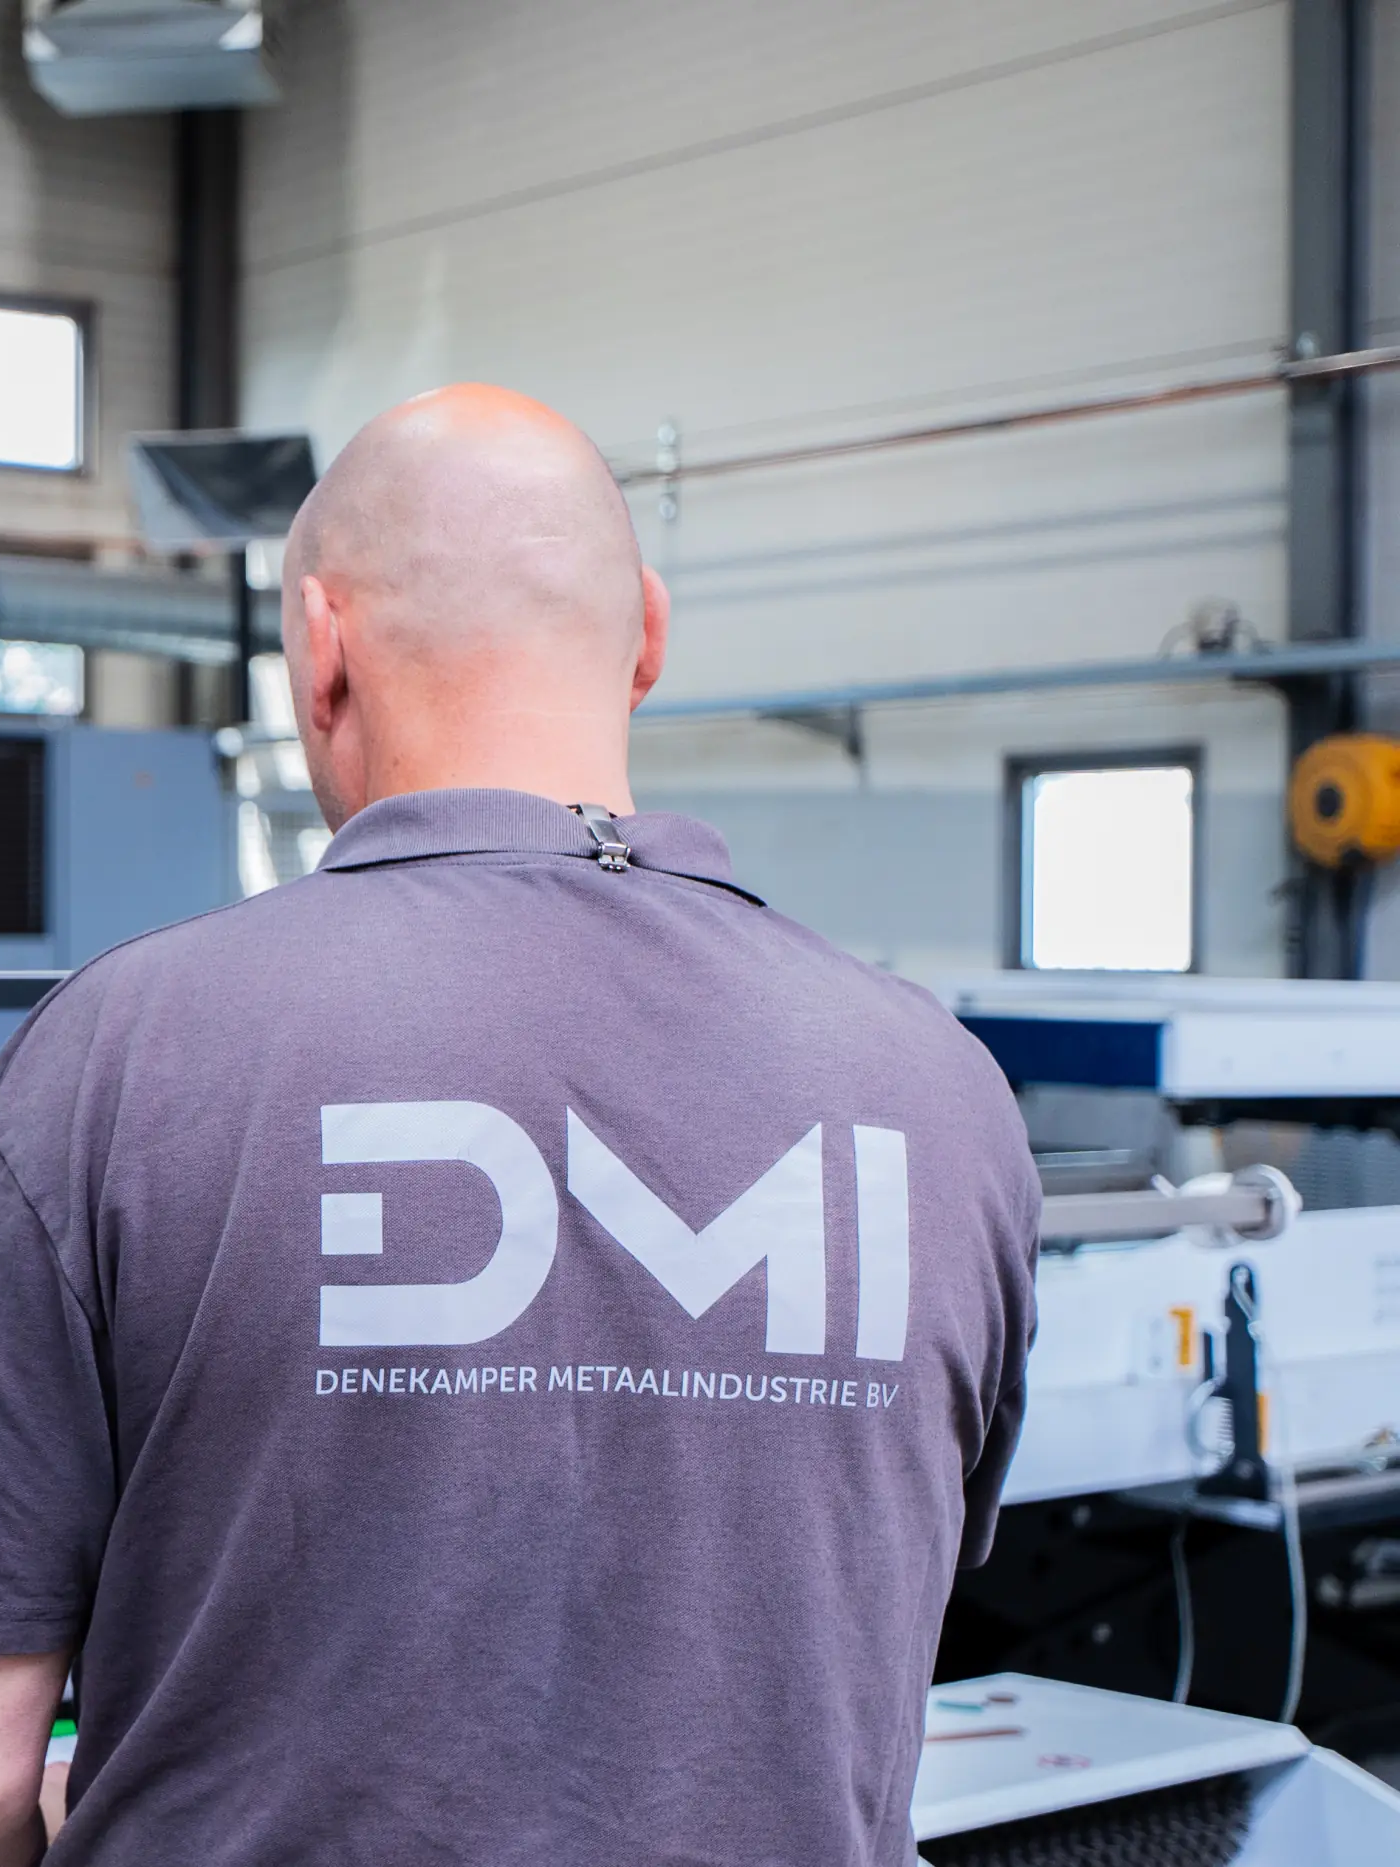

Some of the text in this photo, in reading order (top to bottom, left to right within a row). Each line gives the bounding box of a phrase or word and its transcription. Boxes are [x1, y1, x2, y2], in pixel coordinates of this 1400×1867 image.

[319, 1101, 910, 1362] DMI
[315, 1365, 900, 1409] DENEKAMPER METAALINDUSTRIE BV
